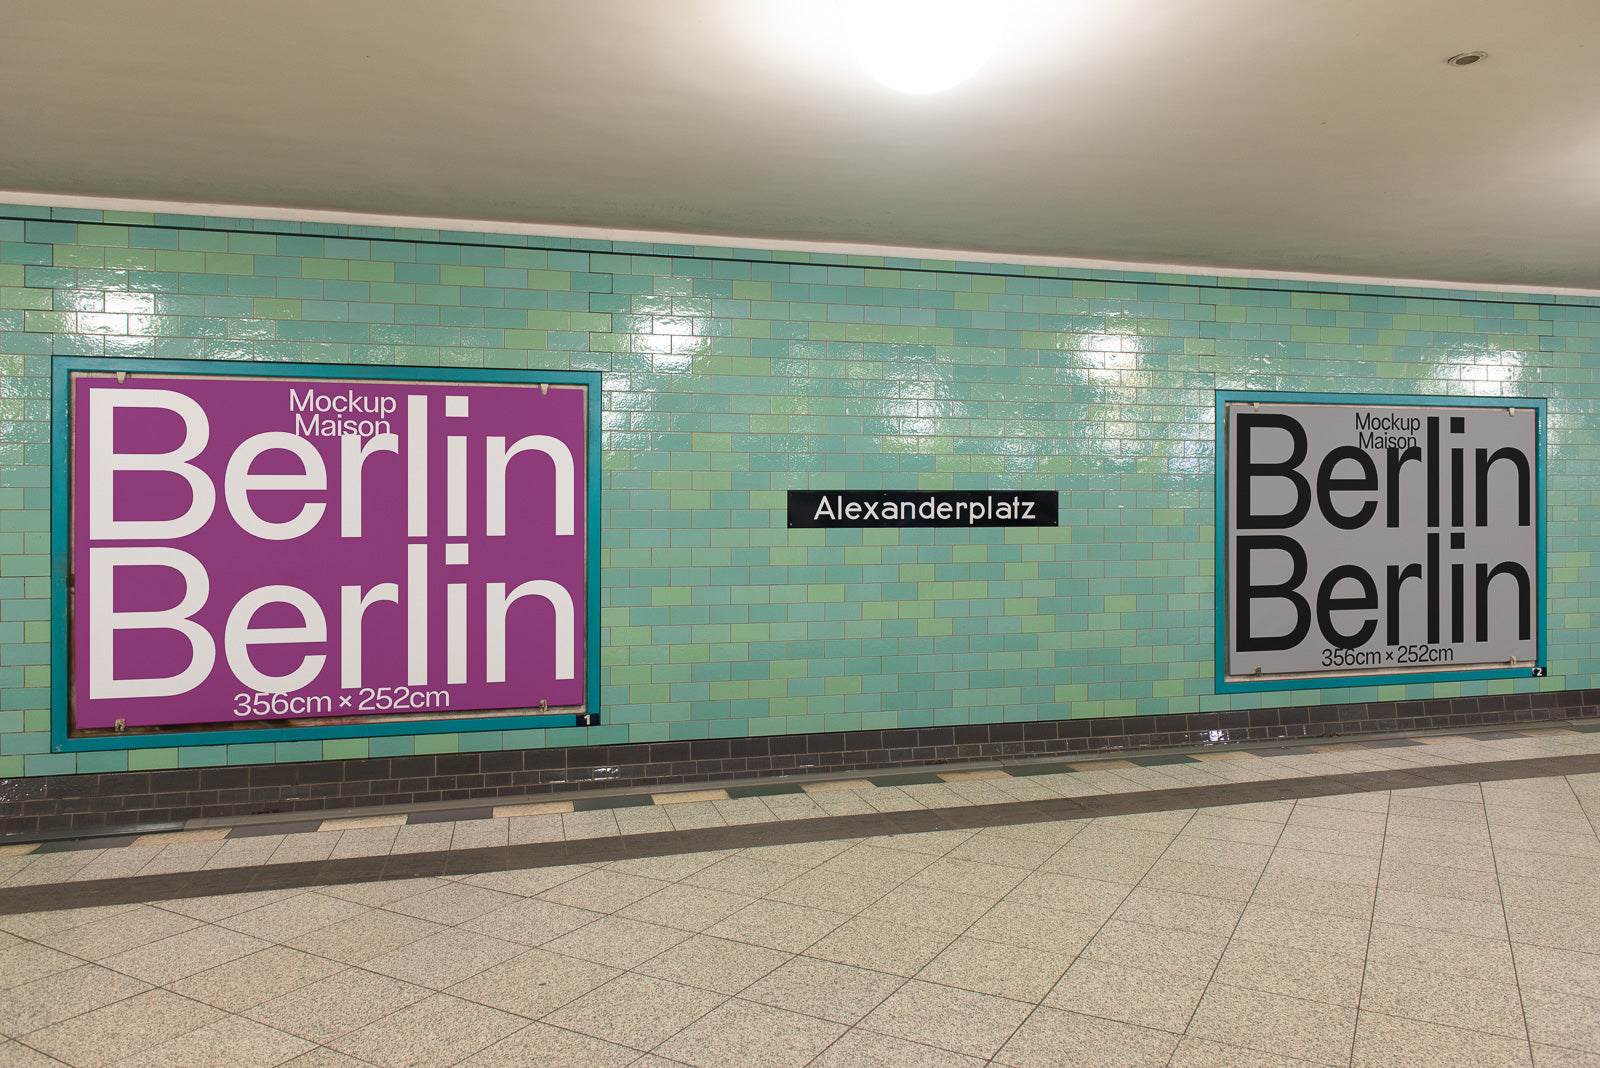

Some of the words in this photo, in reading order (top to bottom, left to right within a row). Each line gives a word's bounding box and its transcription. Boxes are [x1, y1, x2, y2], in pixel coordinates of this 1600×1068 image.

[289, 388, 397, 418] Mockup
[295, 413, 391, 437] Maison
[1355, 412, 1421, 435] Mockup
[1358, 431, 1417, 449] Maison
[89, 387, 575, 541] Berlin
[1236, 413, 1531, 530] Berlin
[813, 495, 1036, 524] Alexanderplatz
[1236, 532, 1531, 653] Berlin
[89, 542, 575, 700] Berlin
[1321, 648, 1382, 667] 356cm
[1397, 645, 1454, 663] 252cm
[1536, 667, 1543, 677] 2
[233, 691, 332, 717] 356cm
[358, 686, 450, 711] 252cm
[583, 714, 591, 726] 1
